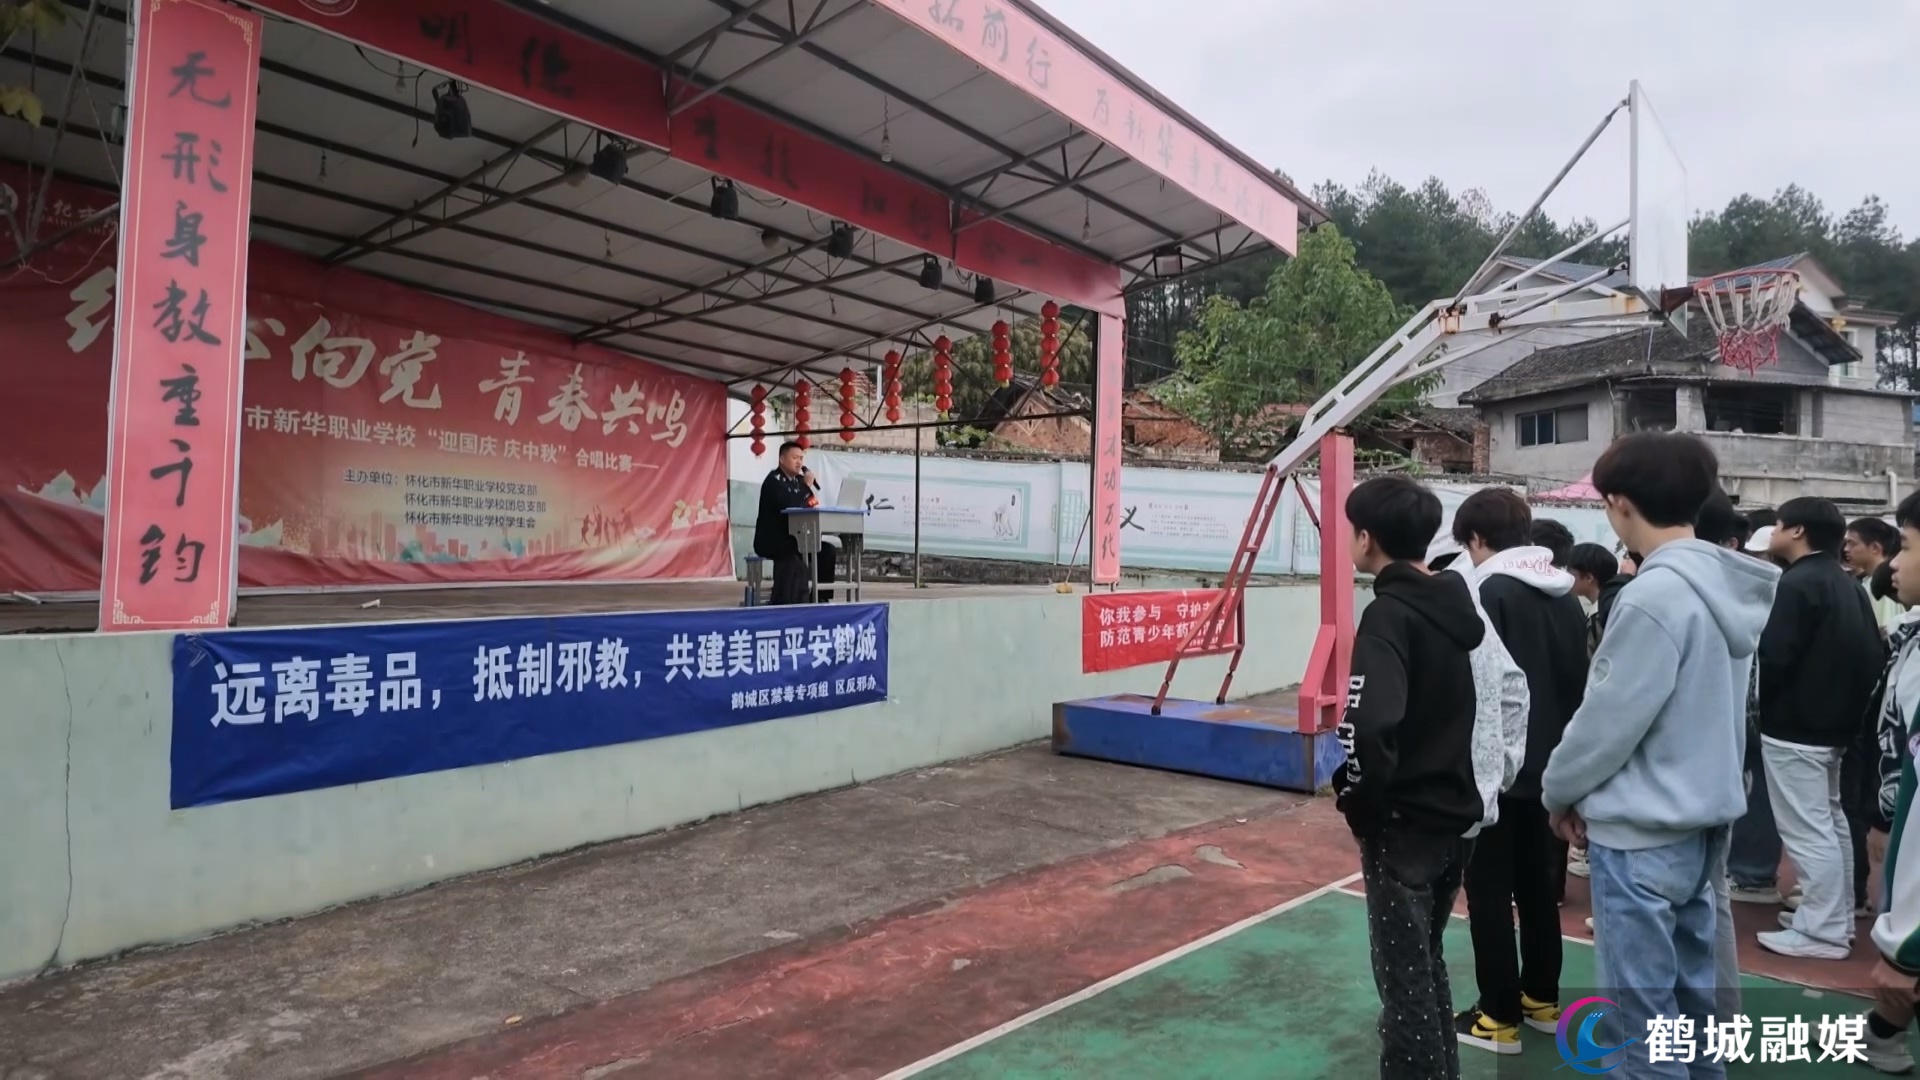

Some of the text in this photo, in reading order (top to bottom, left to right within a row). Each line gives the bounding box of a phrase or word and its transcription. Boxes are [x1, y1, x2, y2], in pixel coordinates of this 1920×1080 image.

[139, 52, 232, 585] 无形身教重千钧
[478, 350, 687, 448] 青春共鸣
[245, 405, 416, 448] 市新华职业学校
[404, 474, 538, 496] 怀化市新华职业学校党支部
[404, 493, 546, 513] 怀化市新华职业学校团总支部
[404, 511, 536, 529] 怀化市新华职业学校学生会
[1100, 604, 1161, 626] 你我参与
[210, 621, 877, 728] 远离毒品， 抵制邪教， 共建美丽平安鹤城
[731, 675, 876, 710] 鹤城区禁毒专项组 区反邪办
